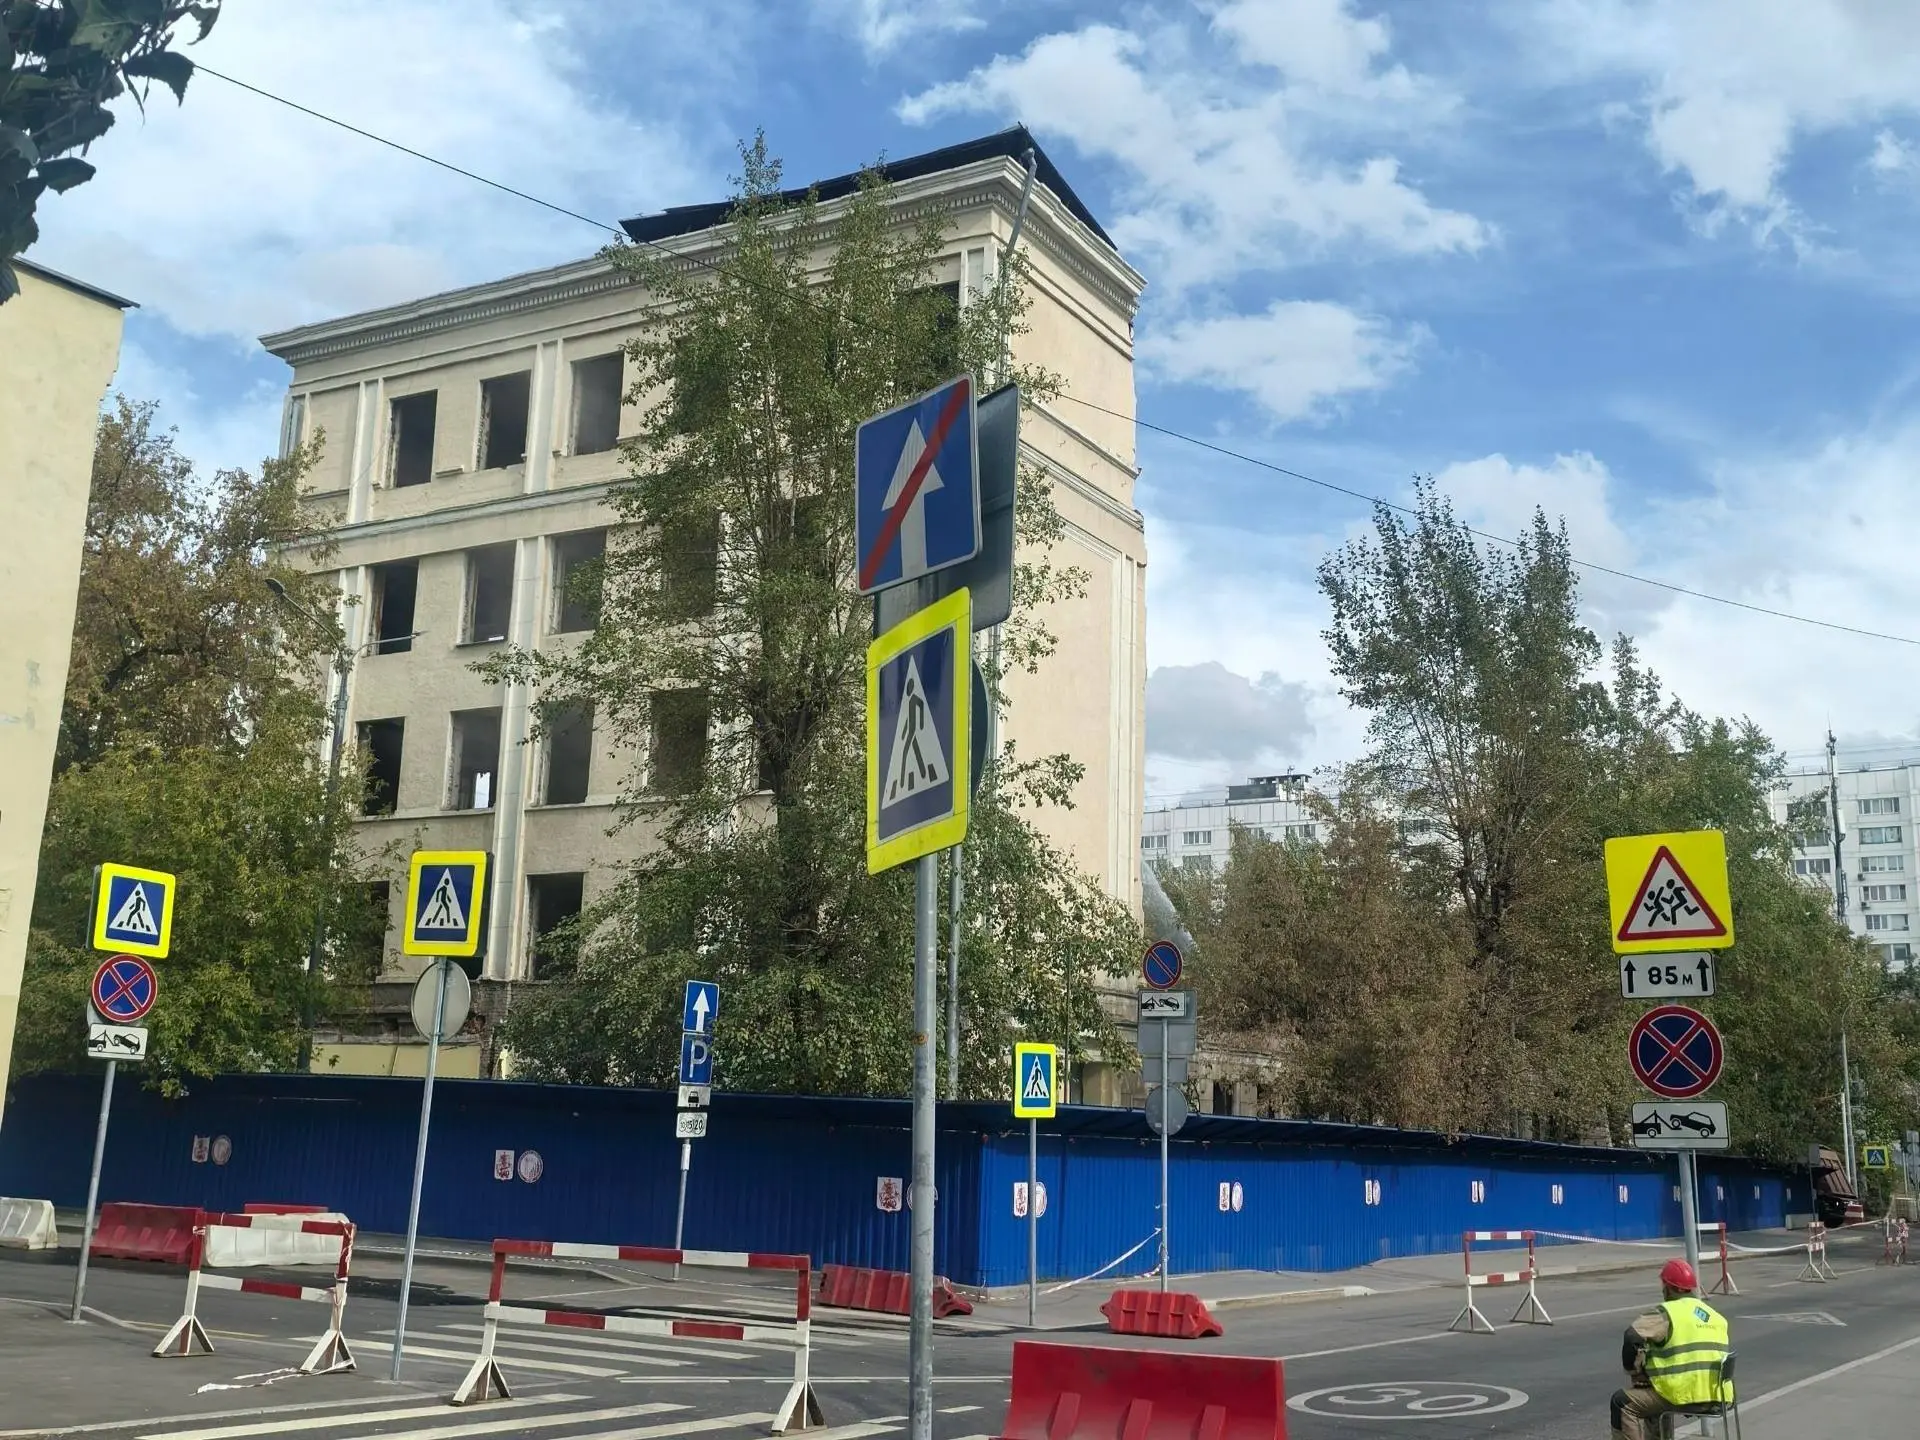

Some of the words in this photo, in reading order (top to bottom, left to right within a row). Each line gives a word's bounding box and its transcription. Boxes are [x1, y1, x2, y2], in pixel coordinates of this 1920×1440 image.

[688, 1040, 708, 1078] P
[694, 1119, 704, 1131] 20
[1328, 1387, 1489, 1411] 30
